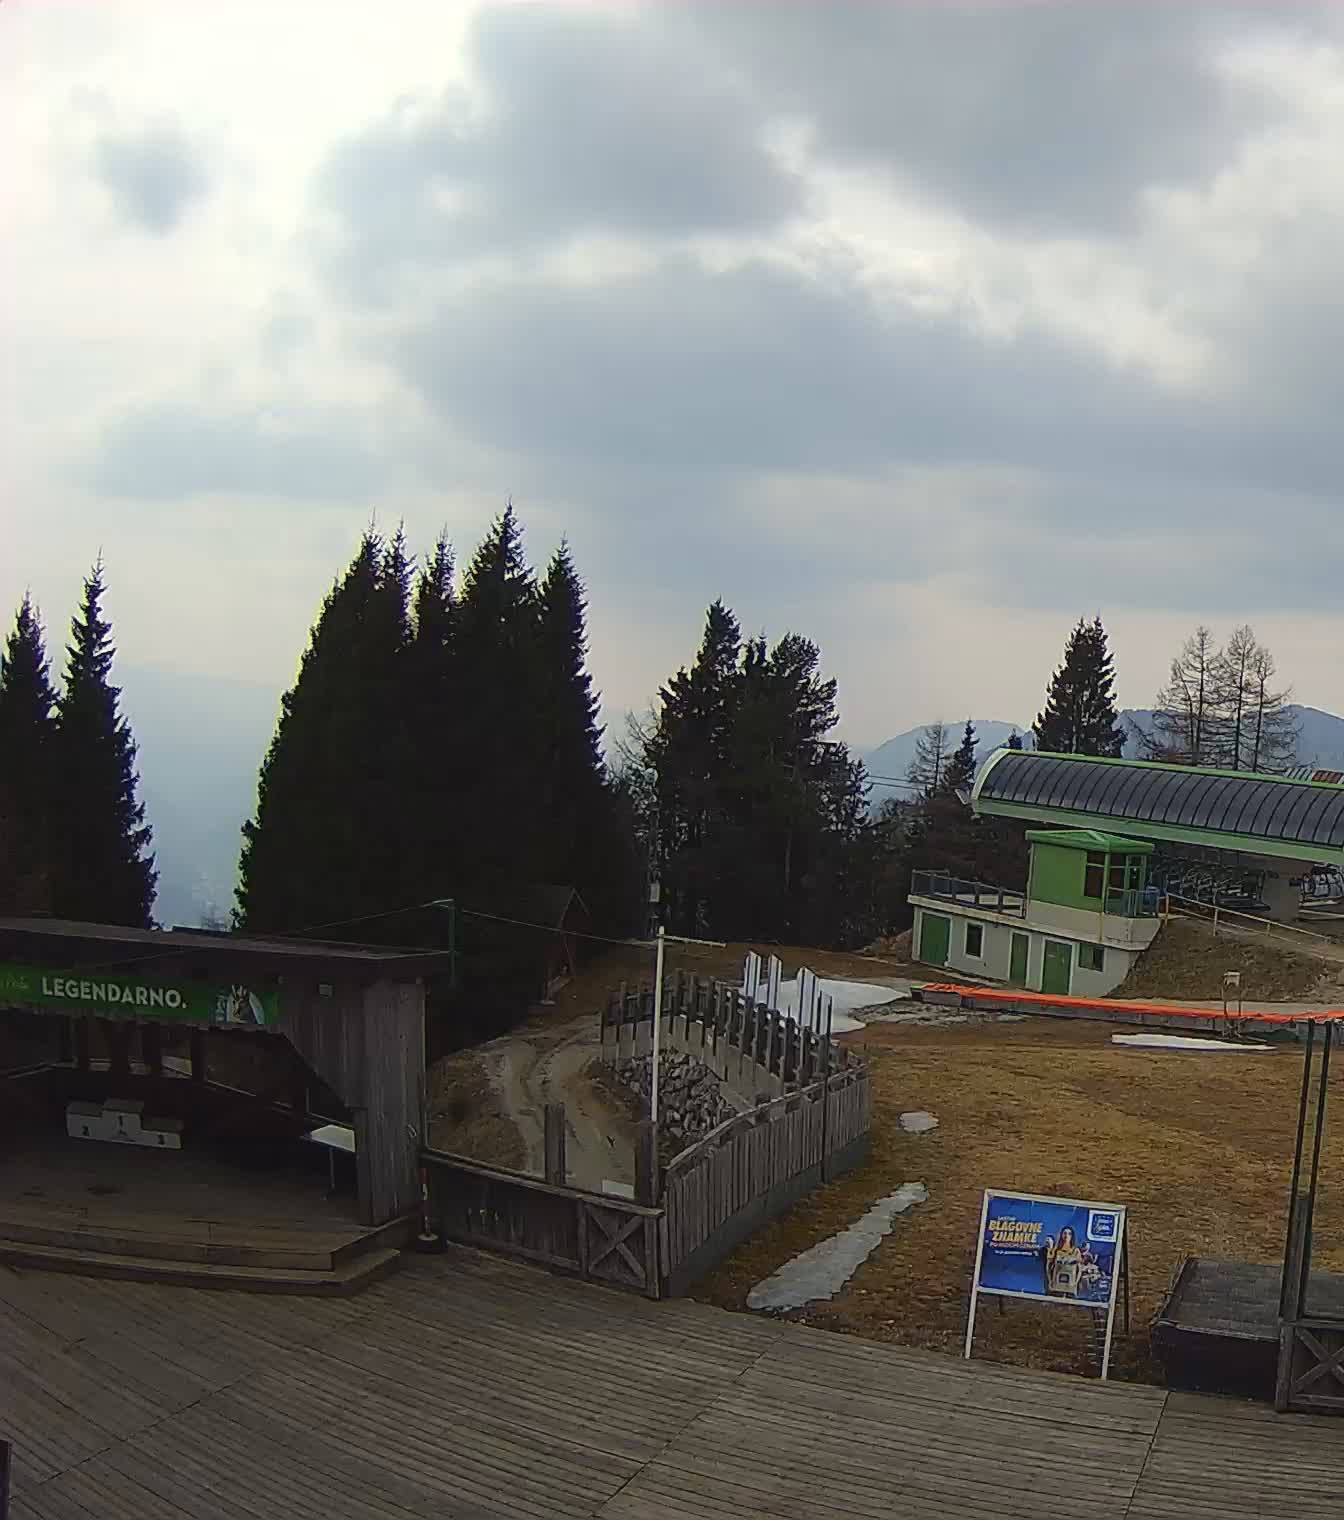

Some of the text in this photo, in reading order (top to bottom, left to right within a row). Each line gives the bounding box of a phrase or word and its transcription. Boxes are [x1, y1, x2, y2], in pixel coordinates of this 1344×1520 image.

[42, 976, 188, 1009] LEGENDARNO.
[988, 1219, 1043, 1233] BLAGOVNE
[991, 1231, 1038, 1244] ZNAMKE
